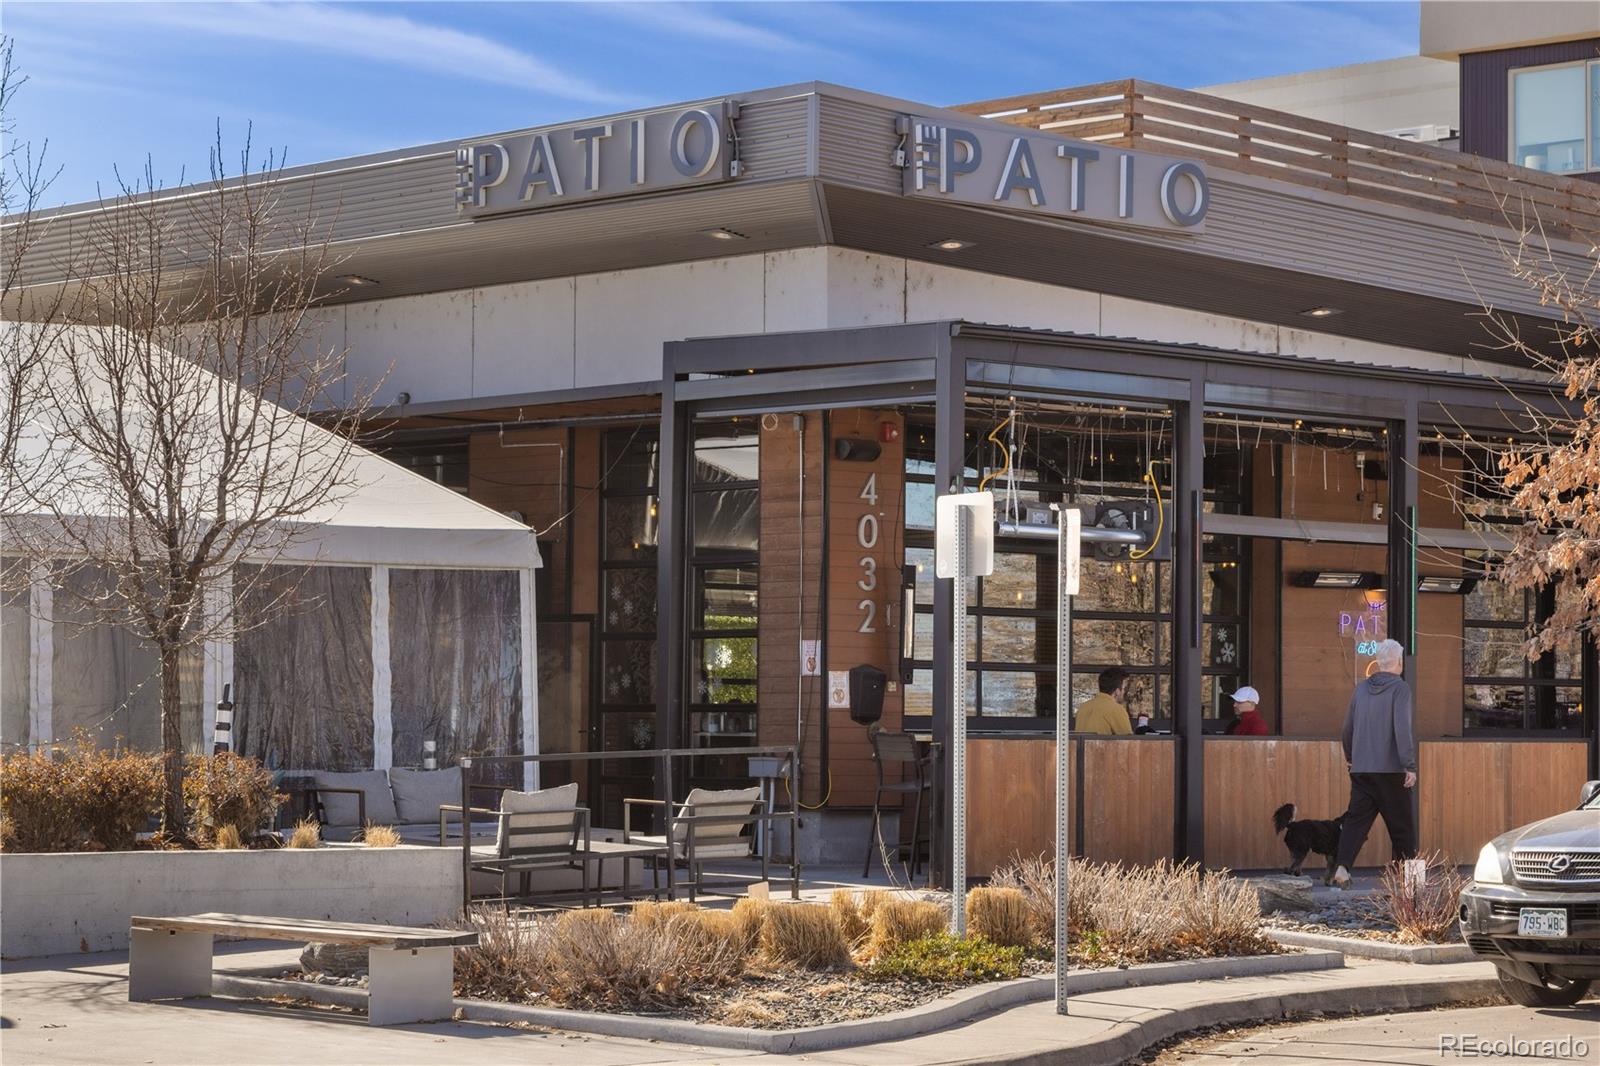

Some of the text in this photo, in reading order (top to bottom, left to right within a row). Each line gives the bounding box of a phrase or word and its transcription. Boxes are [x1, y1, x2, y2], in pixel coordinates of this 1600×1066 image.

[455, 109, 719, 209] THE PATIO
[915, 124, 1210, 227] THE PATIO
[857, 472, 879, 633] 4032
[1340, 613, 1381, 635] PAT
